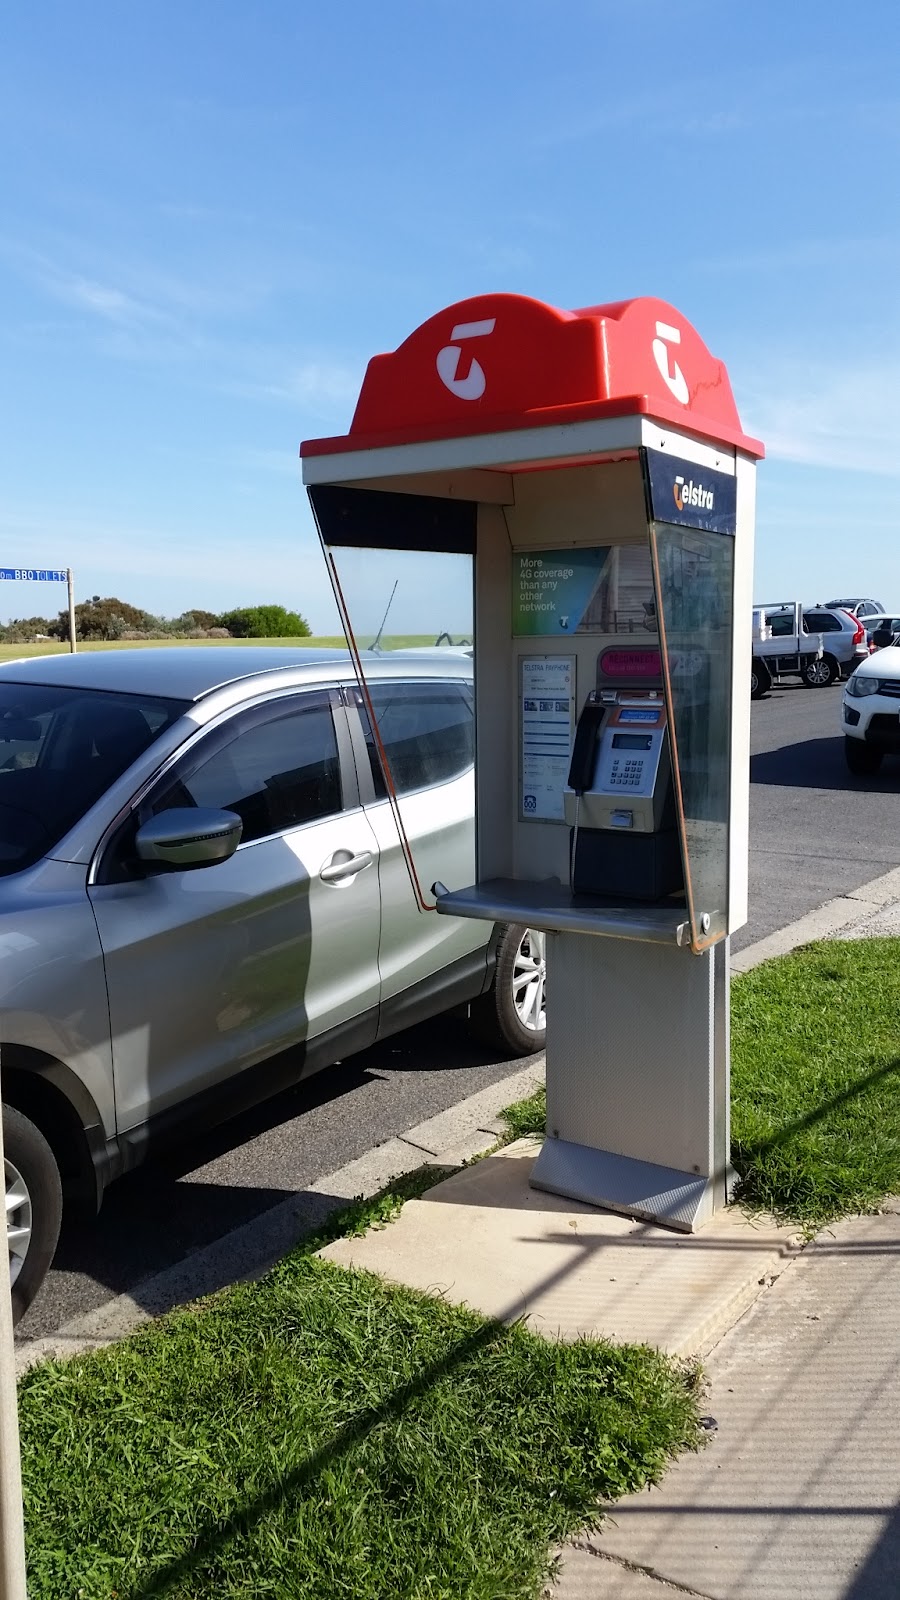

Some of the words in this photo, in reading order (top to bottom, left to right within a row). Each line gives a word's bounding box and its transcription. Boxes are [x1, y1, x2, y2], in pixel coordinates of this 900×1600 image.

[673, 475, 714, 511] Telstra
[520, 558, 543, 568] More
[14, 570, 34, 580] BBQ
[36, 570, 67, 581] TOILETS
[520, 569, 532, 579] 4G
[533, 568, 574, 580] coverage
[520, 580, 540, 590] than
[541, 580, 558, 591] any
[520, 591, 543, 601] other
[520, 601, 556, 612] network
[524, 664, 544, 672] TELSTRA
[545, 664, 571, 672] PAYPHONE
